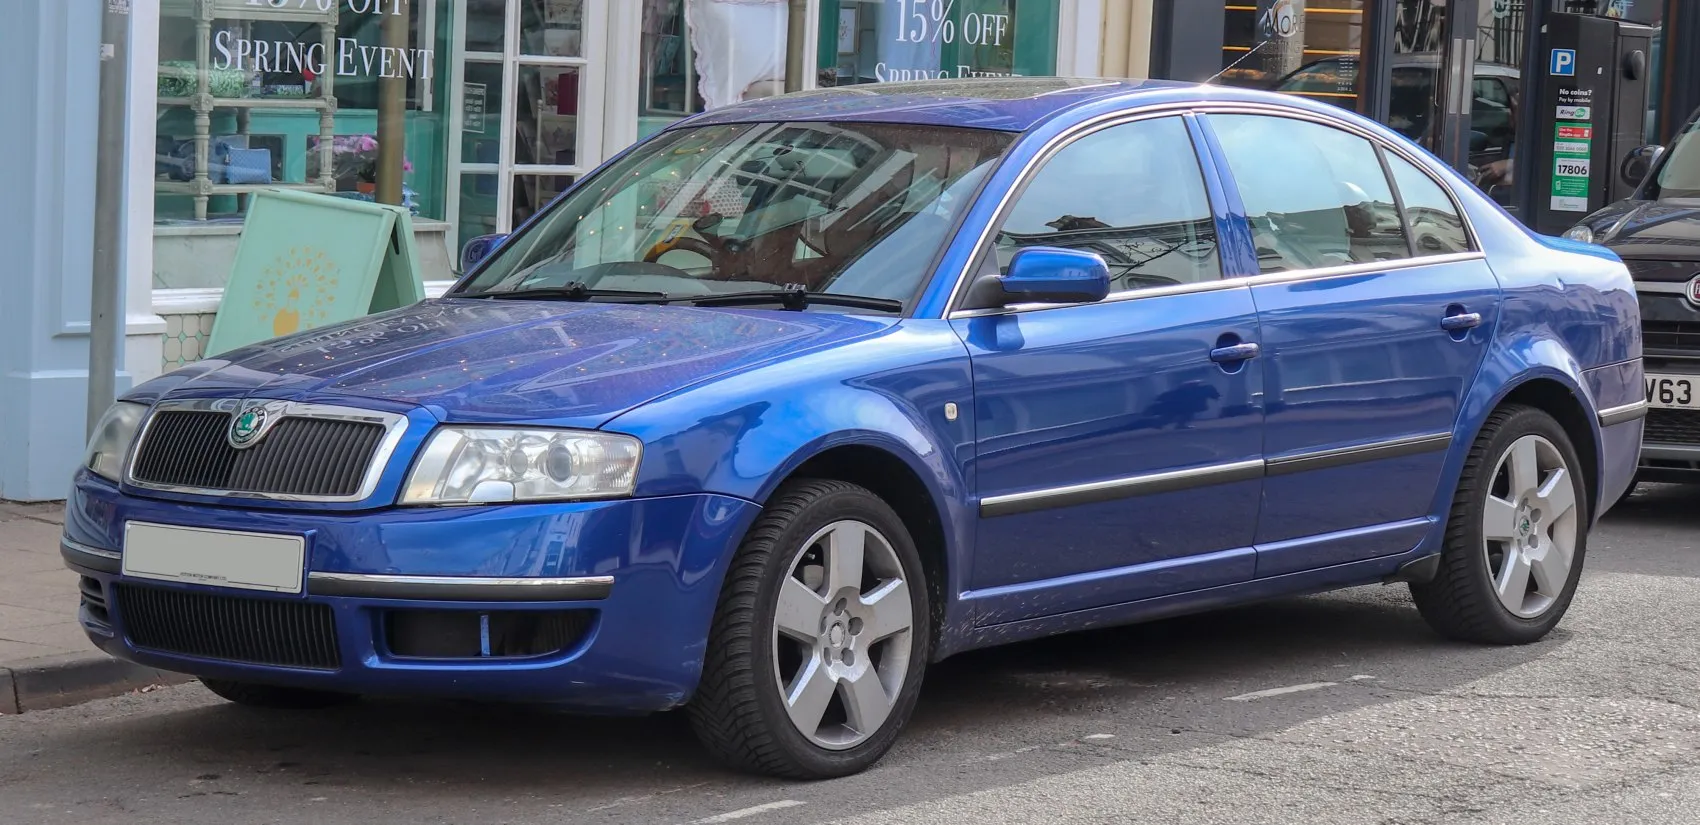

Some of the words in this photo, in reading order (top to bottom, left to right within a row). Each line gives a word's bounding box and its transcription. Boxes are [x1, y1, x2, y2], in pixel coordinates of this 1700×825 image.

[896, 0, 954, 43] 15%
[964, 12, 1009, 46] OFF
[213, 30, 328, 76] SPRING
[336, 37, 435, 80] EVENT
[1557, 164, 1587, 175] 17806
